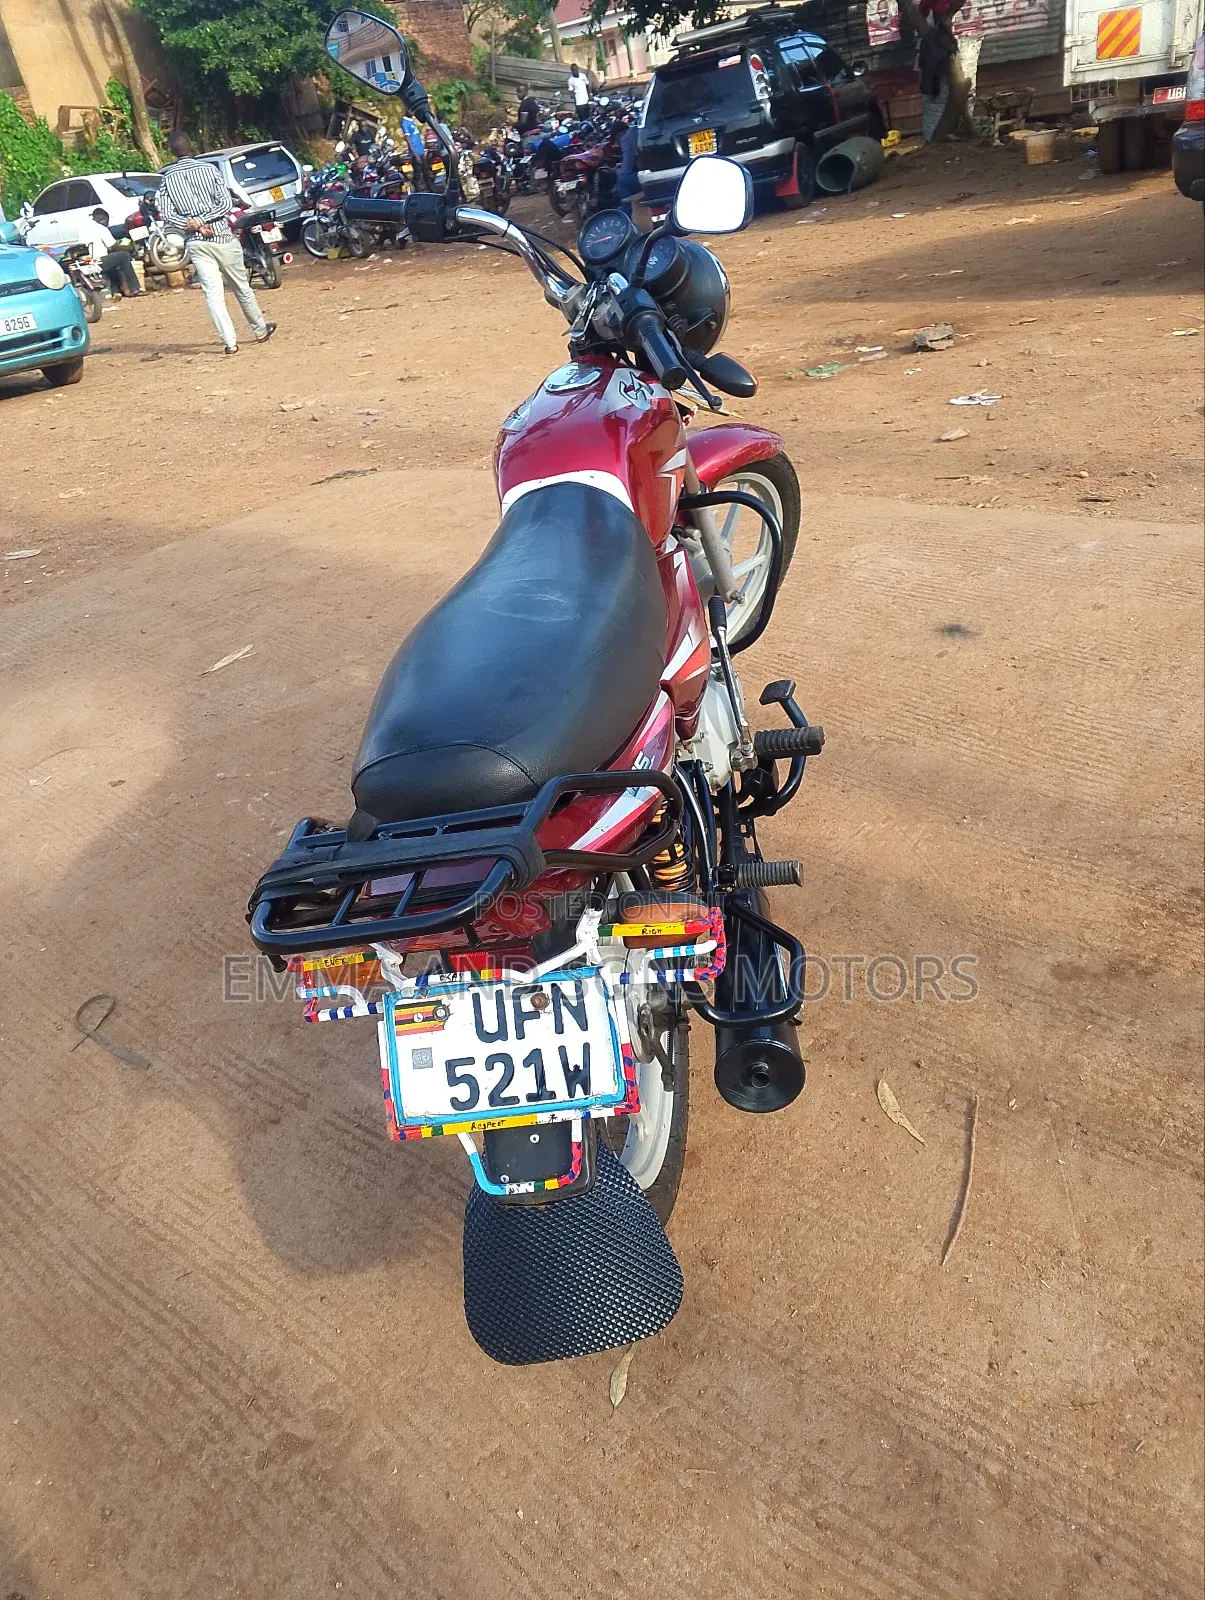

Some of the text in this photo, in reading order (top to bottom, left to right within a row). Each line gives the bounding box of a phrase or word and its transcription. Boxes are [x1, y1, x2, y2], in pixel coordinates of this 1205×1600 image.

[4, 316, 30, 332] 825G
[471, 979, 588, 1043] UFN
[444, 1042, 591, 1111] 521W
